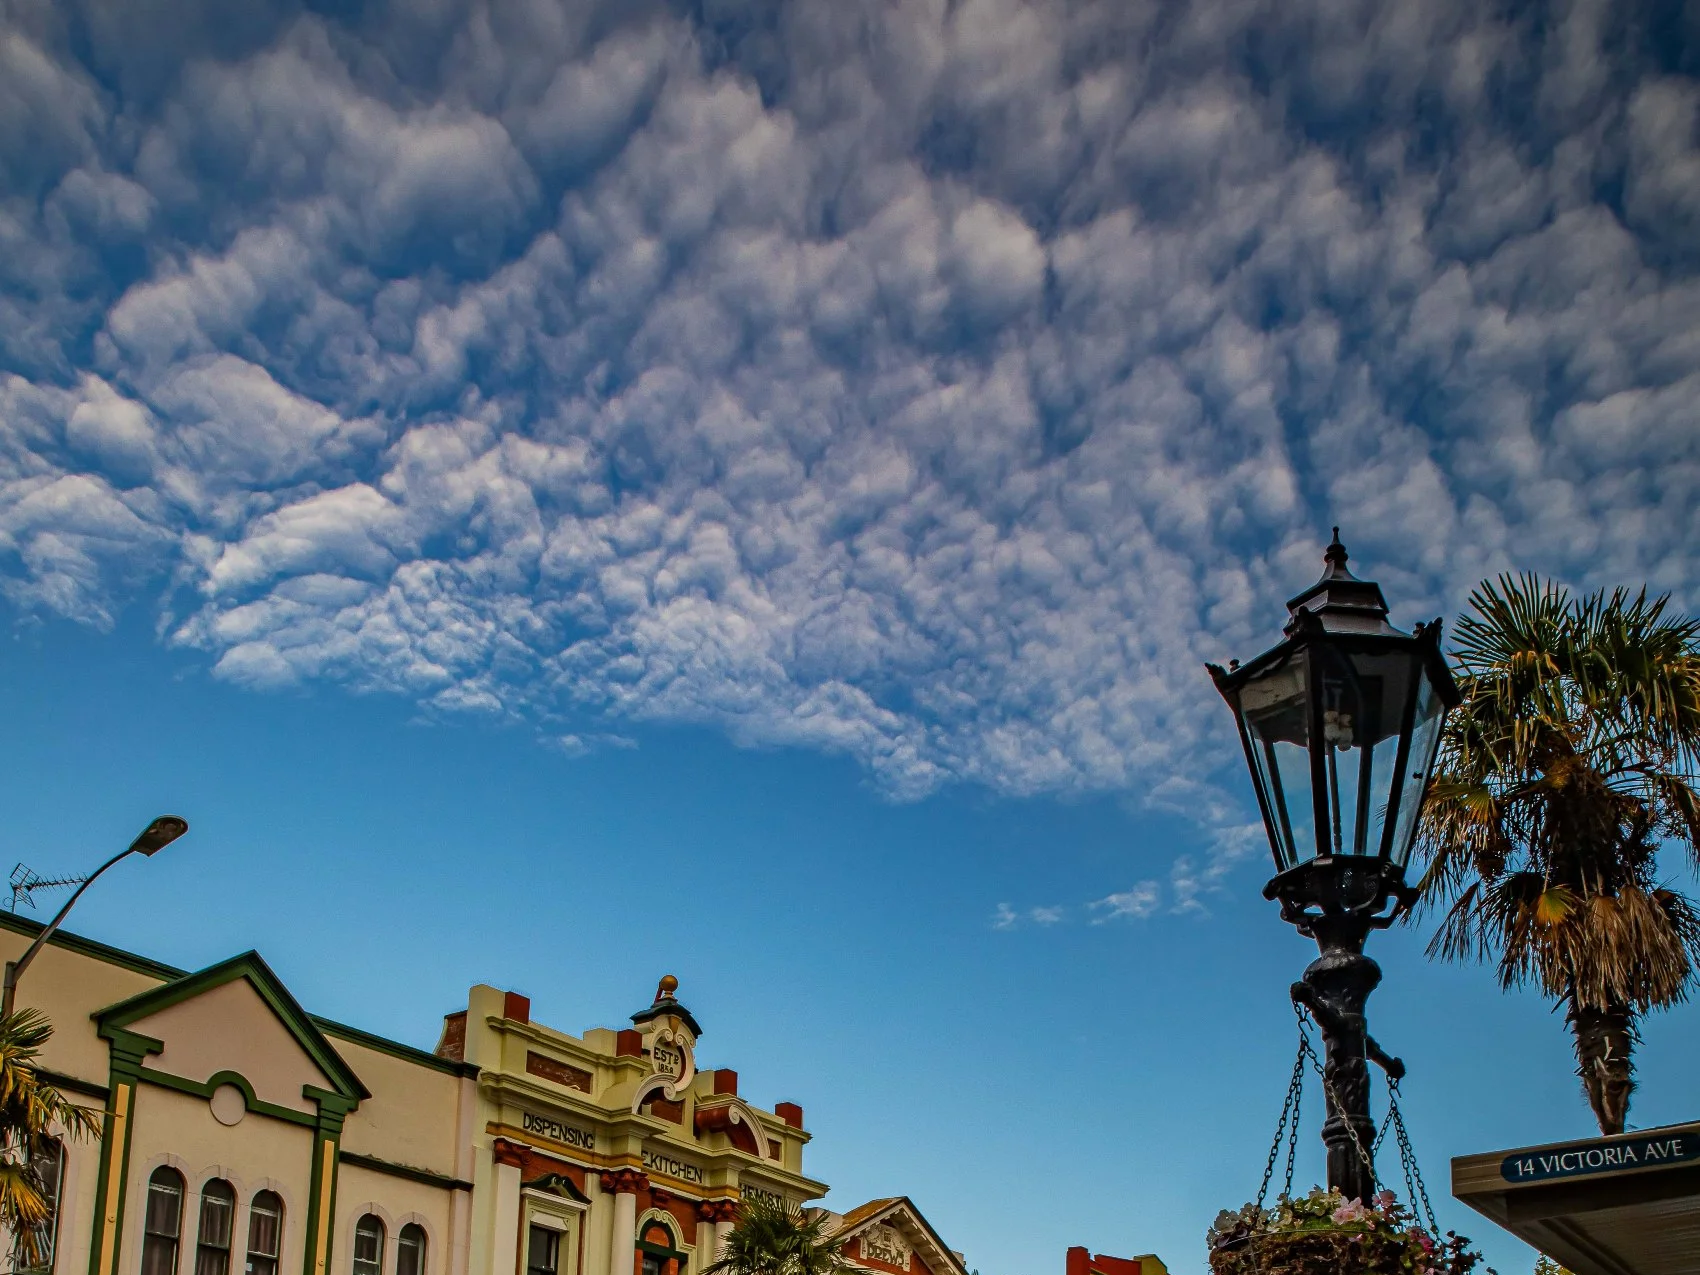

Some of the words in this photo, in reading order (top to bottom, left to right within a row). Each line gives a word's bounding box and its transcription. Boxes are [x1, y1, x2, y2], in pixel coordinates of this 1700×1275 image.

[523, 1112, 594, 1149] DISPENSING
[1515, 1159, 1535, 1177] 14
[1538, 1147, 1638, 1173] VICTORIA
[1644, 1139, 1685, 1161] AVE
